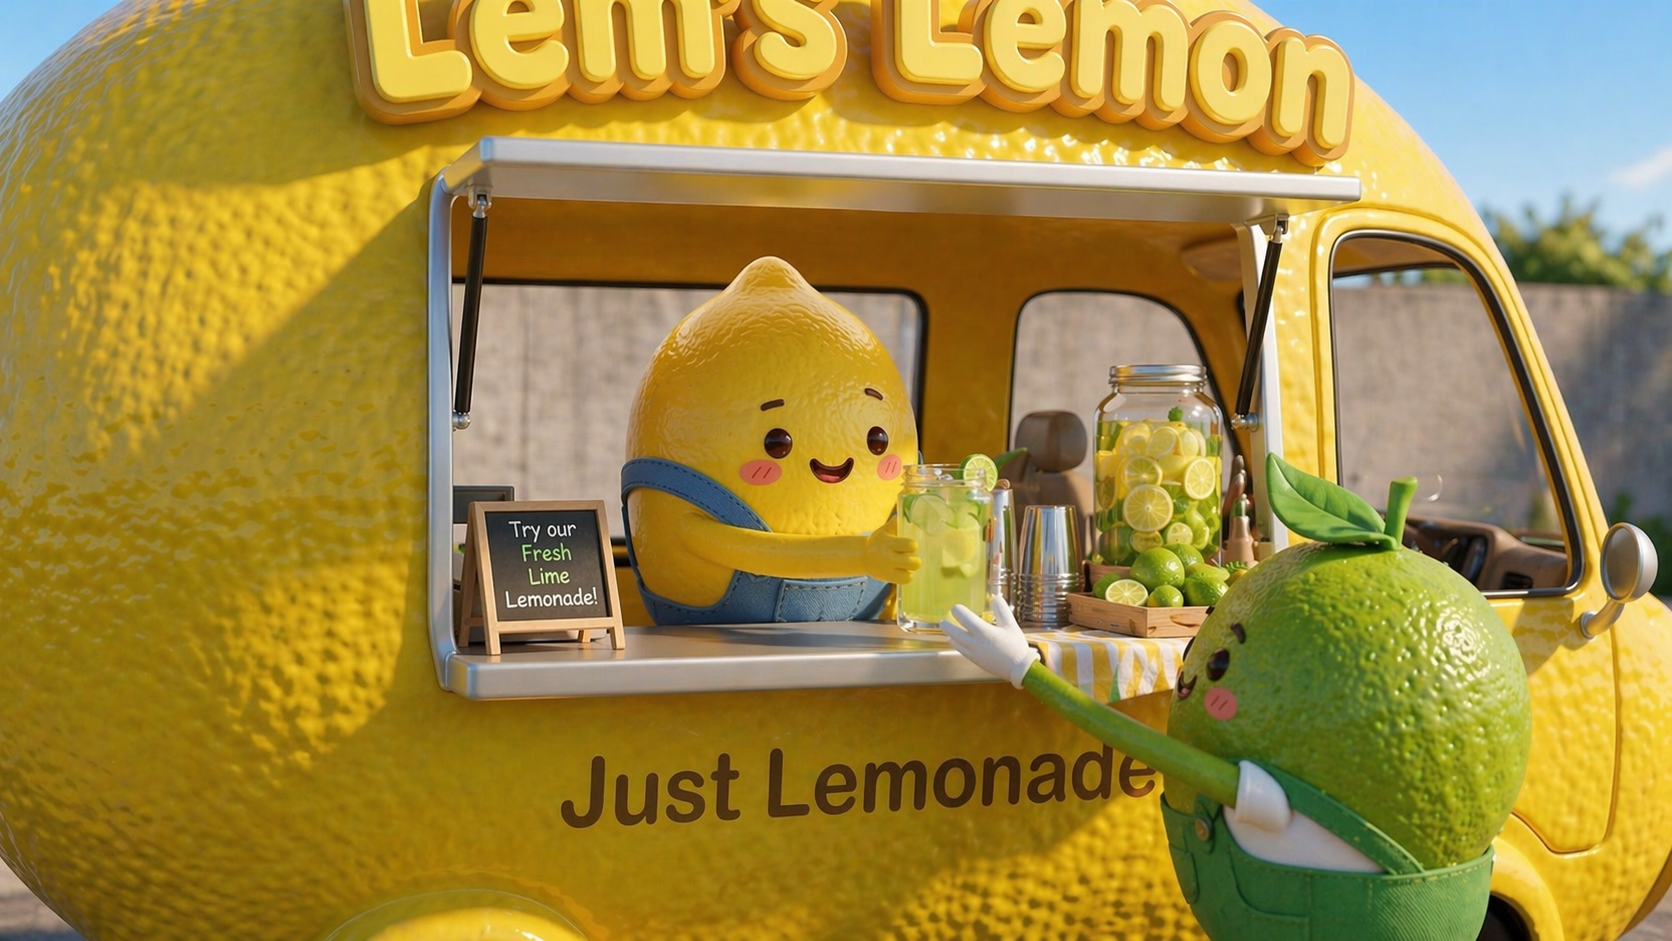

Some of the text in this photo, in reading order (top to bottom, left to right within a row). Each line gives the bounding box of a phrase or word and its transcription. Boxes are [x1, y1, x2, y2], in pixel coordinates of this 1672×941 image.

[357, 0, 1353, 158] Lems Lemon
[508, 520, 576, 542] Try our
[521, 542, 572, 562] Fresh
[528, 567, 570, 586] Lime
[504, 586, 598, 608] Lemonade!
[560, 743, 1157, 828] Just Lemonade
